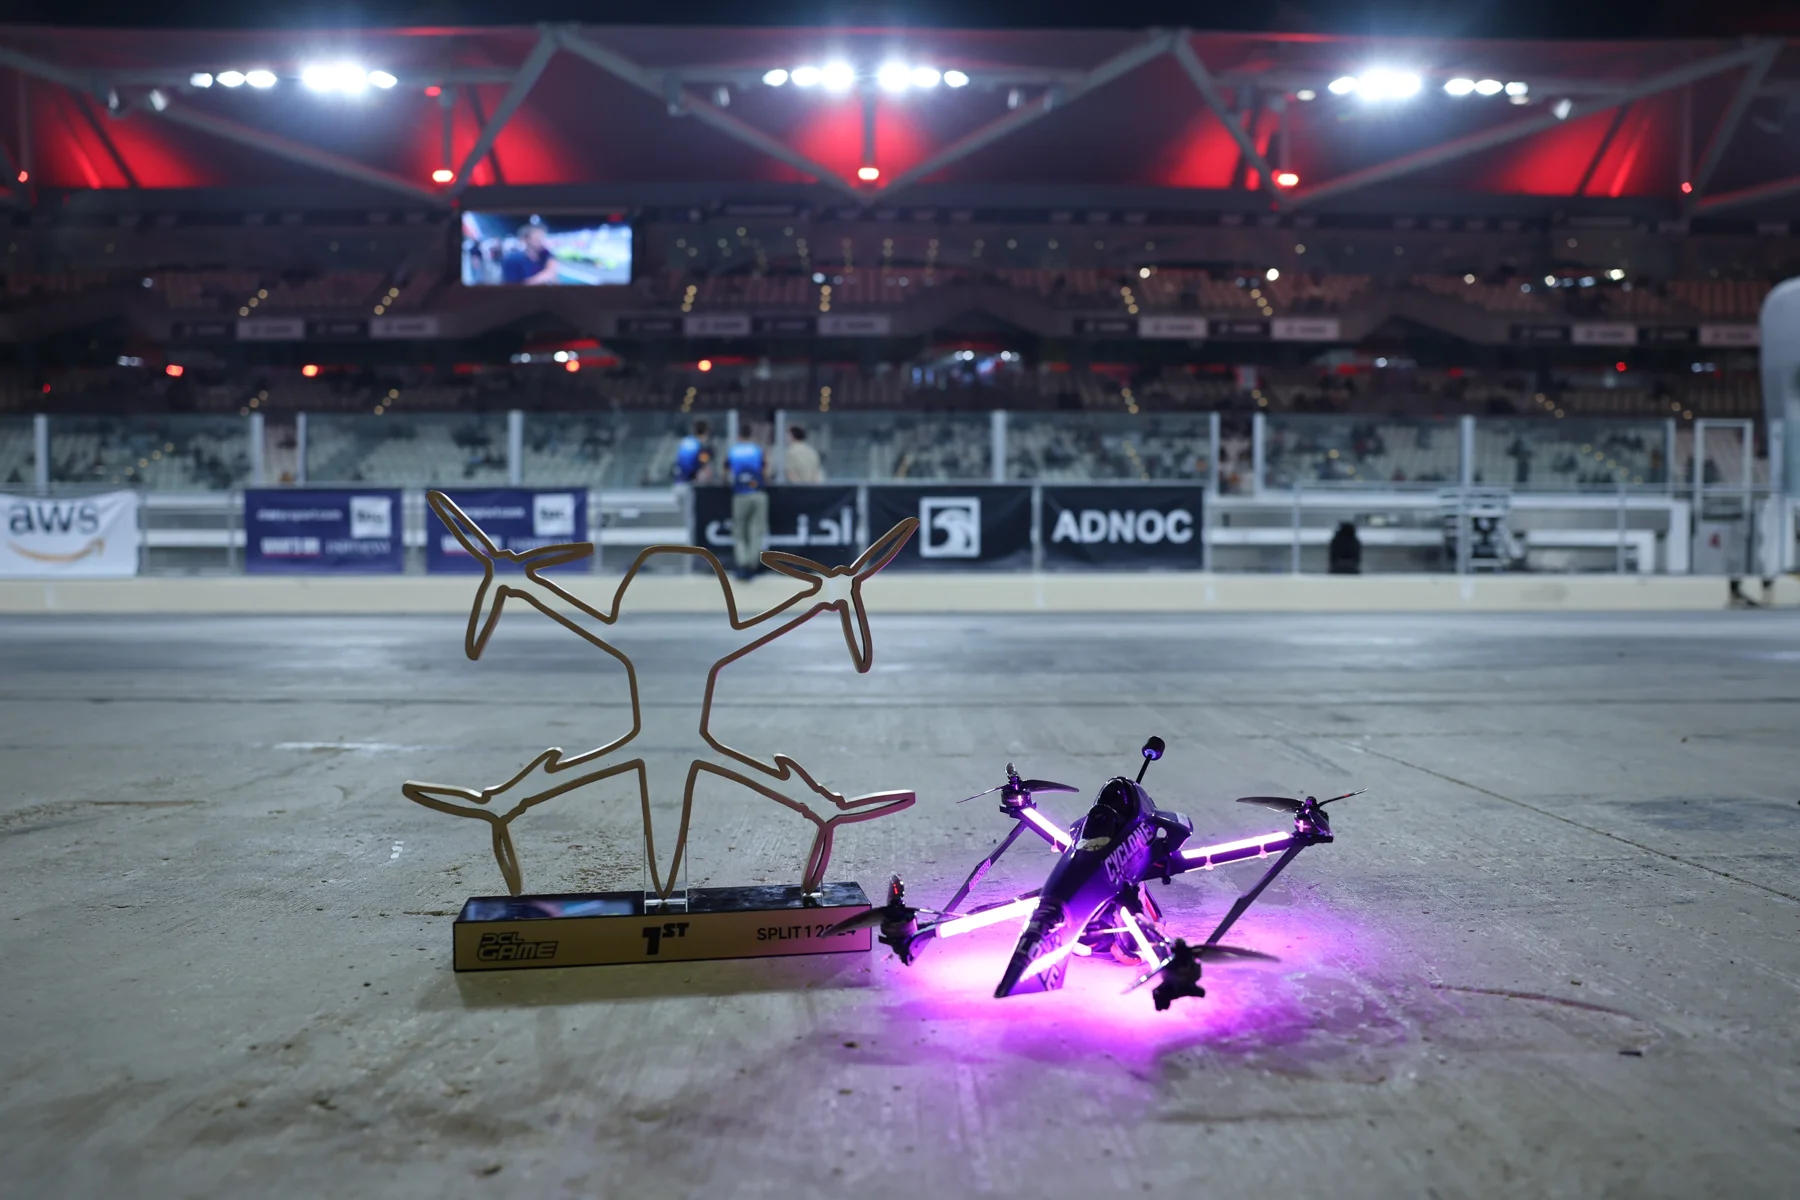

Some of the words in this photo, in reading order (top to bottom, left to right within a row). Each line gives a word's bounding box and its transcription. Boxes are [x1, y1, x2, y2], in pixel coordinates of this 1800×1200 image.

[8, 502, 99, 536] aws
[1051, 508, 1194, 545] ADNOC
[1104, 821, 1154, 882] CYCLONE
[757, 926, 801, 940] SPLIT
[804, 925, 811, 938] 1
[477, 941, 559, 962] GAME
